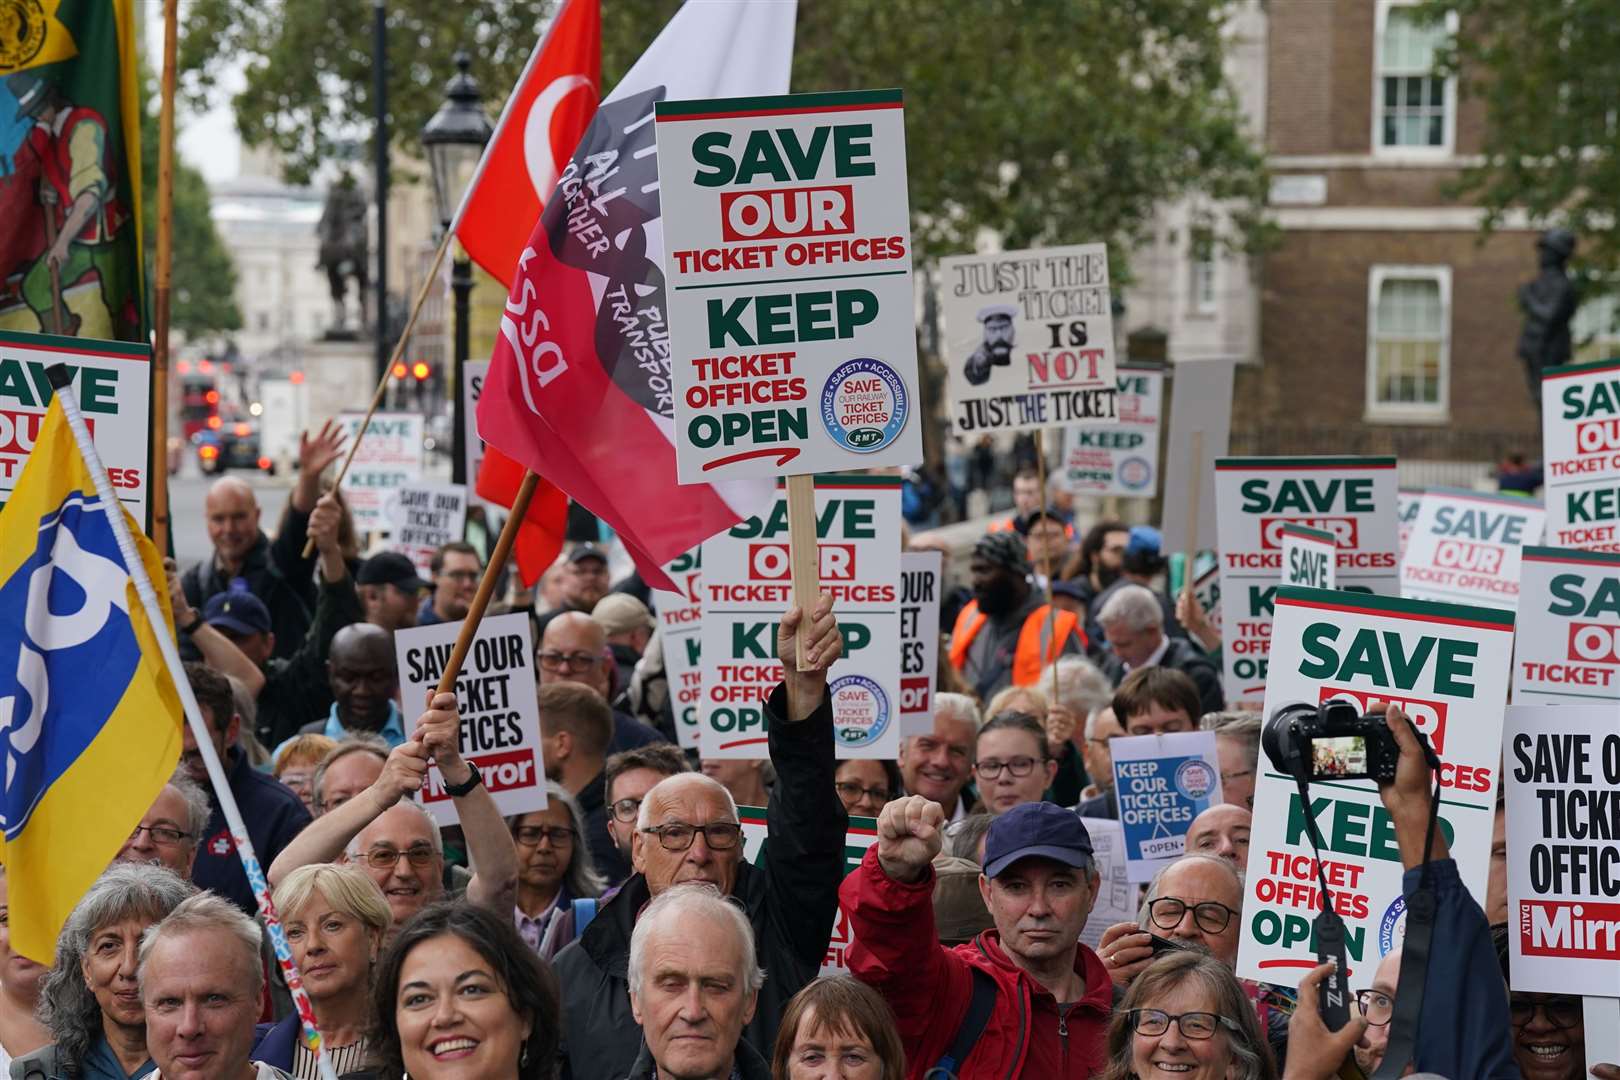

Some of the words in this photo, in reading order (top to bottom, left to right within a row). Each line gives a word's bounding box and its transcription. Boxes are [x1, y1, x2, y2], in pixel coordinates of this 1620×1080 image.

[692, 123, 876, 187] SAVE
[584, 149, 627, 216] ALL
[557, 158, 609, 259] OGETHER
[728, 190, 848, 237] OUR
[673, 245, 778, 273] TICKET
[784, 236, 905, 266] OFFICES
[953, 259, 1040, 297] JUST
[1045, 253, 1104, 287] THE
[707, 289, 879, 349] KEEP
[1018, 287, 1110, 321] TICKET
[637, 305, 672, 379] PUB
[1047, 321, 1088, 348] IS
[691, 352, 796, 381] TICKET
[831, 361, 863, 385] SAFETY
[1027, 349, 1104, 383] NOT
[0, 359, 118, 414] AVE
[686, 378, 807, 409] OFFICES
[839, 394, 856, 404] OUR
[857, 392, 888, 403] RAILWAY
[844, 379, 882, 394] SAVE
[869, 363, 904, 423] ACCESSIBILITY
[1116, 376, 1148, 395] VE
[1563, 381, 1620, 419] SA
[823, 391, 836, 426] ADVICE
[841, 412, 888, 426] OFFICES
[844, 401, 884, 414] TICKET
[959, 396, 1014, 430] JUST
[1014, 393, 1047, 425] THE
[1051, 388, 1118, 420] TICKET
[688, 408, 808, 449] OPEN
[855, 433, 877, 443] RMT
[1079, 431, 1143, 449] KEEP
[1580, 421, 1620, 452] OU
[1550, 457, 1606, 477] TICKET
[1240, 479, 1375, 514] SAVE
[1567, 489, 1620, 523] KE
[1265, 519, 1354, 547] OR
[1431, 506, 1527, 545] SAVE
[1558, 526, 1615, 545] TICKET
[753, 546, 851, 578] OR
[1226, 553, 1282, 568] TICKE
[1336, 553, 1396, 567] FICES
[1290, 547, 1328, 589] SAVE
[1437, 542, 1500, 574] OUR
[708, 585, 792, 602] TICKET
[819, 585, 896, 602] FICES
[1406, 566, 1455, 584] TICKET
[1458, 574, 1519, 594] OFFICES
[1548, 574, 1620, 618] SA
[663, 607, 701, 625] TICK
[1237, 623, 1272, 637] TIC
[732, 622, 872, 659] KP
[407, 642, 468, 683] SAV
[475, 634, 525, 673] OUR
[717, 666, 784, 682] TICKE
[1298, 622, 1479, 698] SAVE
[1522, 662, 1615, 686] TICKET
[426, 674, 510, 716] CKET
[839, 692, 868, 701] SAVE
[710, 708, 768, 732] OP
[835, 716, 873, 725] OFFICES
[838, 708, 870, 716] TICKET
[460, 712, 524, 753] FICES
[1118, 762, 1158, 778] KEEP
[1513, 733, 1592, 784] SAVE
[1121, 791, 1178, 809] TICKET
[1131, 777, 1168, 793] OUR
[1124, 806, 1192, 824] OFFICES
[1536, 789, 1620, 840] TICK
[1149, 841, 1178, 853] OPEN
[1267, 851, 1364, 889] TICKET
[1530, 844, 1620, 897] OFFIC
[1255, 878, 1369, 919] OFFICES
[1521, 904, 1531, 936] DAILY
[1532, 905, 1620, 951] Mirr
